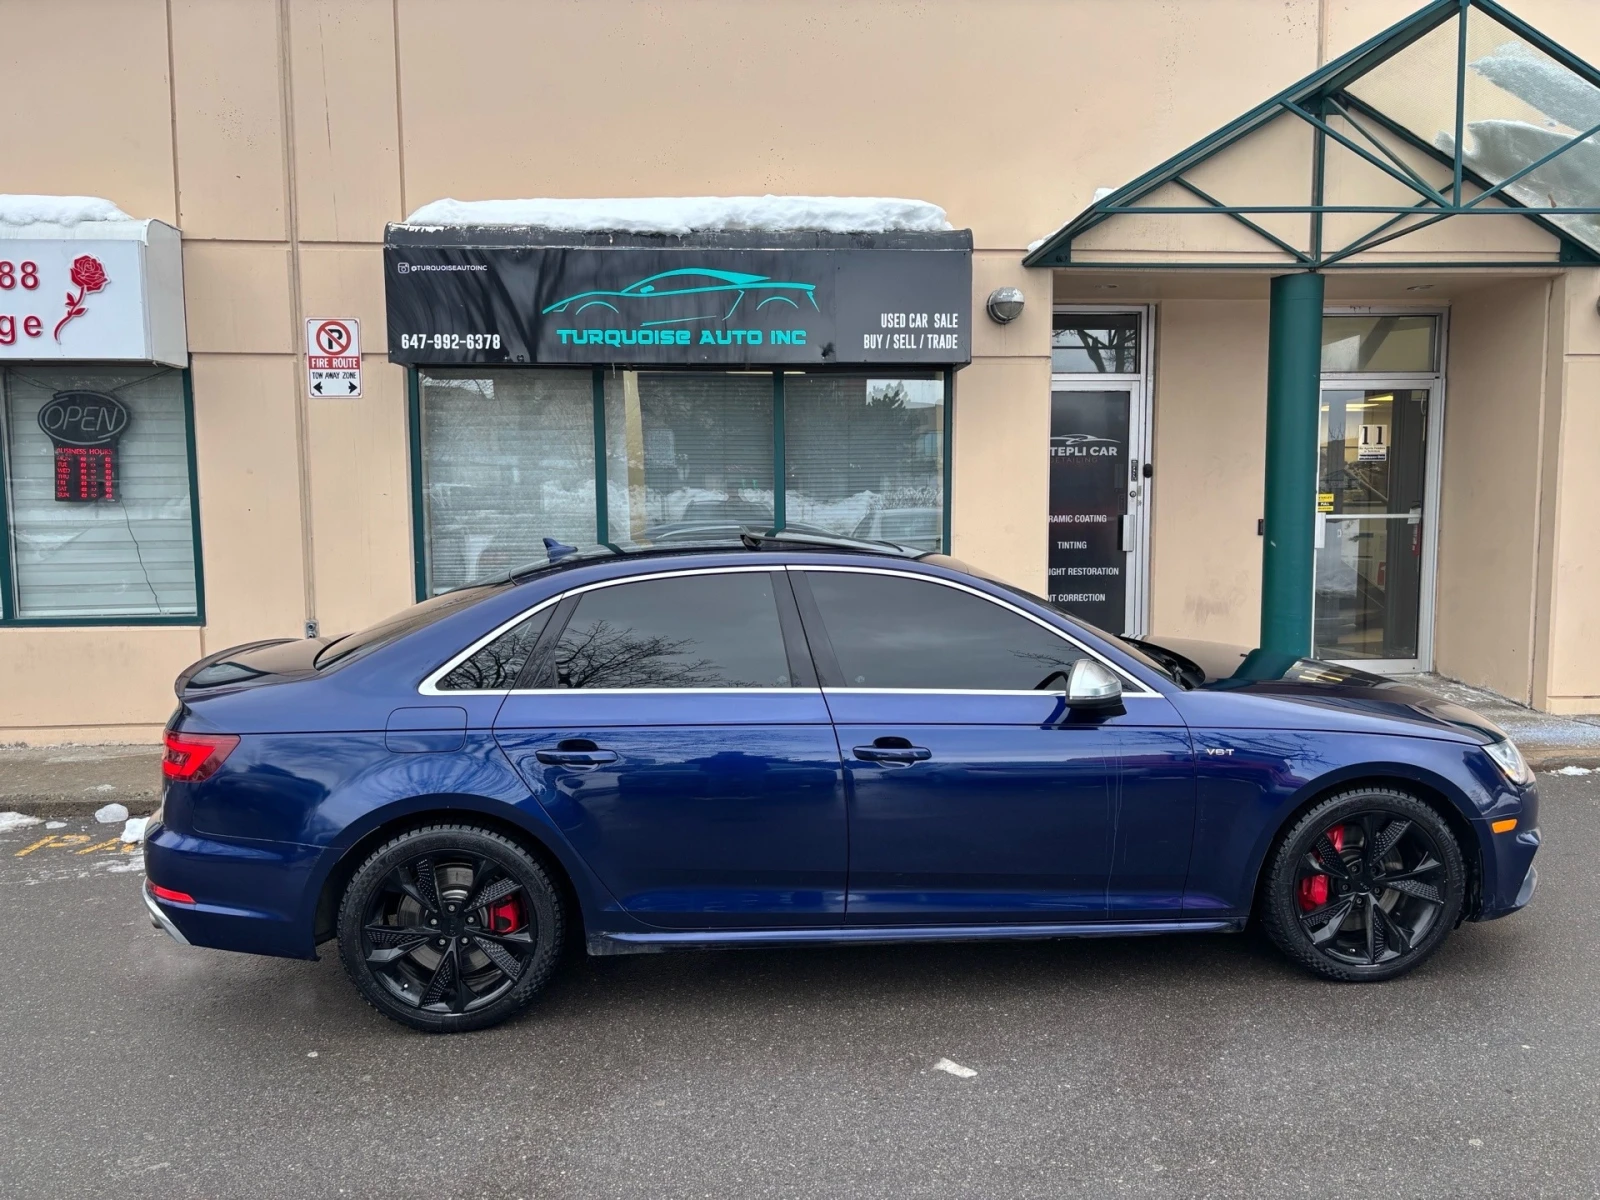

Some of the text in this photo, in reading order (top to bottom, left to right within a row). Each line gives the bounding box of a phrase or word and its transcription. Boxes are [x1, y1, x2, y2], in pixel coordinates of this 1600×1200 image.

[410, 264, 488, 272] @TURQUOISEAUTOINC
[0, 260, 39, 290] 88
[881, 313, 959, 328] USED CAR SALE
[0, 314, 43, 345] ge
[401, 333, 501, 350] 647-992-6378
[556, 329, 807, 347] TURQUOISE AUTO INC
[863, 333, 883, 349] BUY
[893, 333, 917, 349] SELL
[927, 333, 958, 349] TRADE
[311, 357, 358, 369] FIRE ROUTE
[312, 371, 357, 380] TOW AWAY ZONE
[44, 405, 118, 431] OPEN
[1362, 425, 1384, 445] 11
[1049, 446, 1118, 456] TEPLI CAR
[1074, 514, 1107, 523] COATING
[1057, 541, 1088, 550] TINTING
[1067, 567, 1119, 576] RESTORATION
[1058, 593, 1106, 602] CORRECTION
[1206, 748, 1235, 756] V6T
